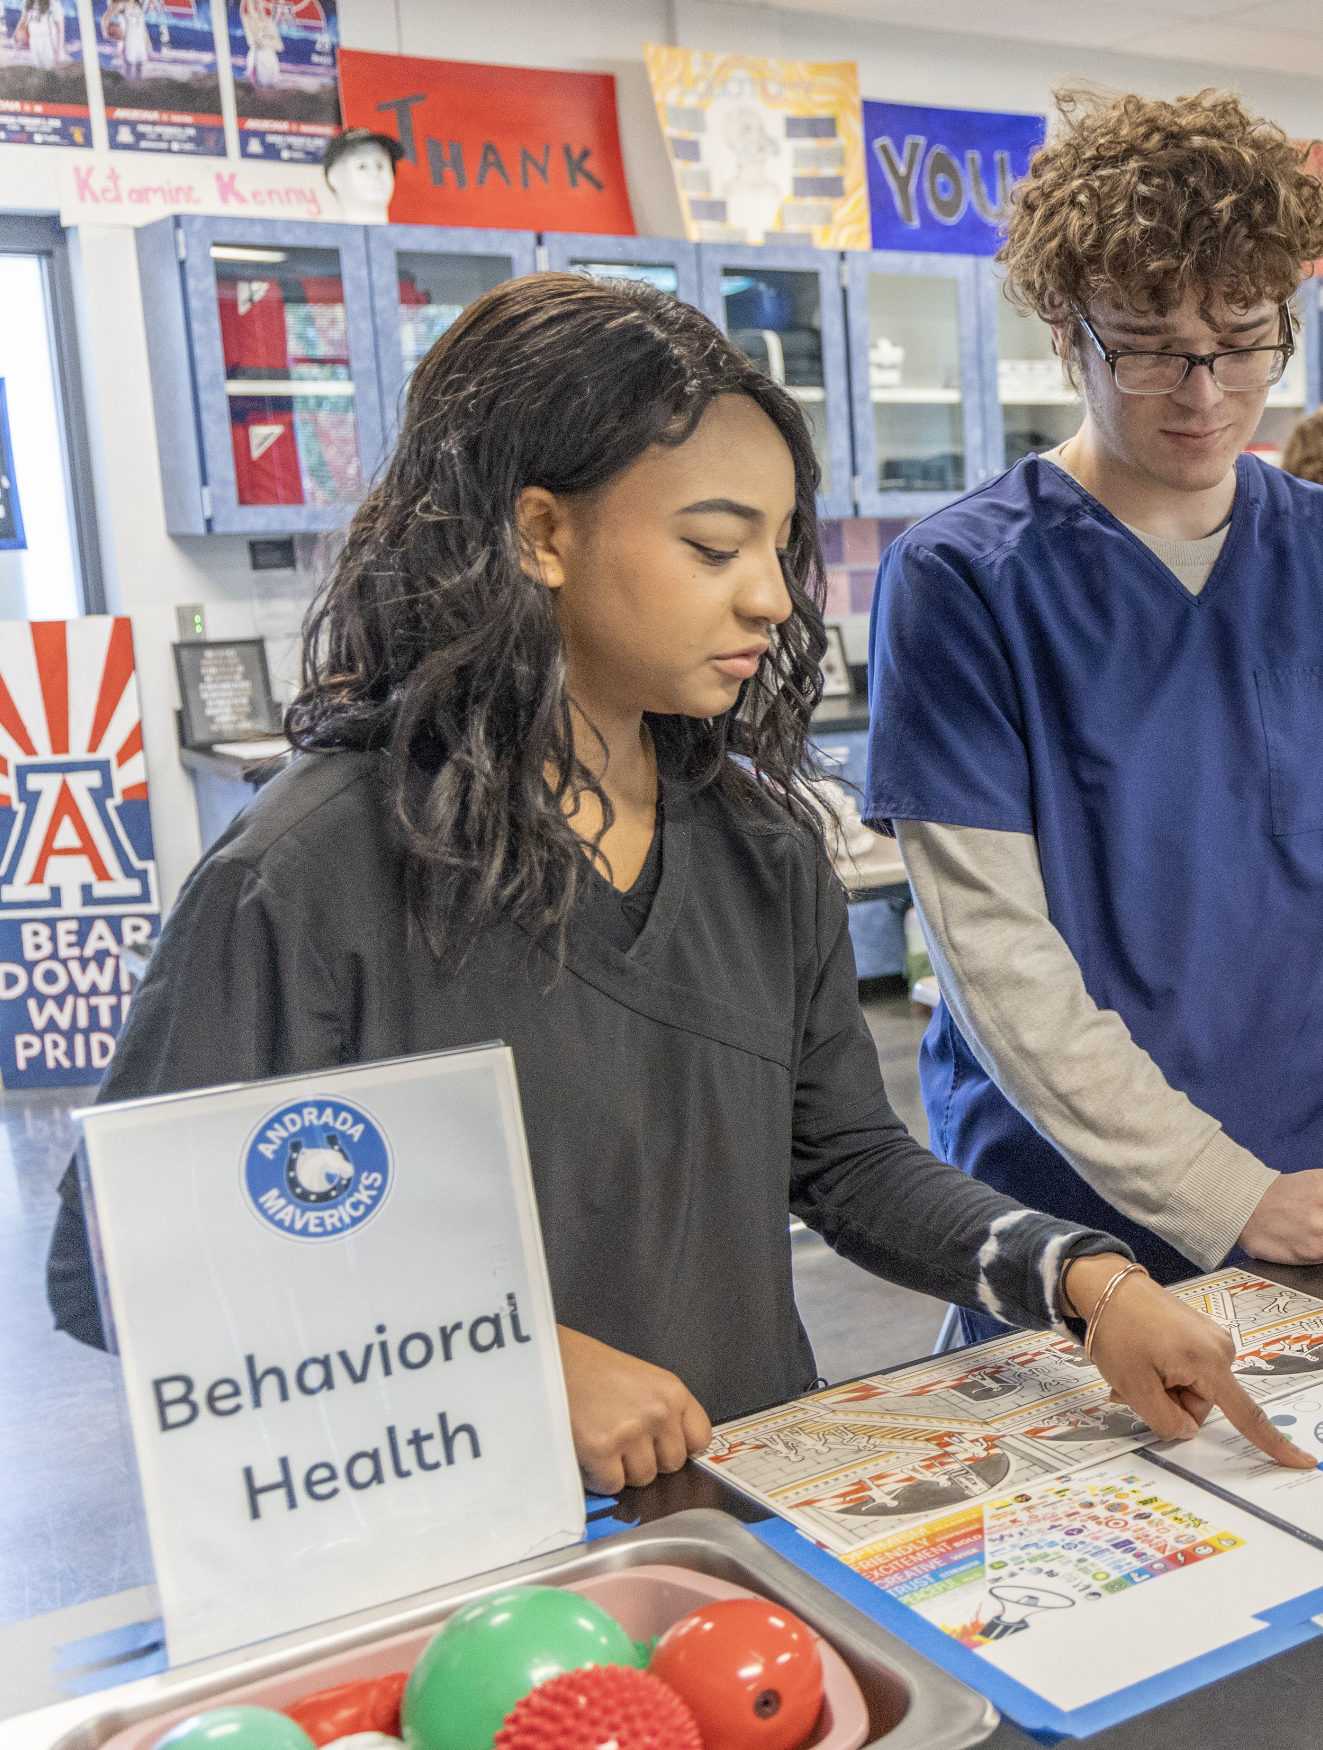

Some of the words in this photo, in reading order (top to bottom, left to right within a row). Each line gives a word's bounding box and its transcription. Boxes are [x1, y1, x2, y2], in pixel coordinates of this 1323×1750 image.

[376, 93, 604, 191] THANK
[214, 171, 322, 217] Kenny
[873, 135, 1012, 229] YOU
[2, 770, 142, 900] A
[21, 916, 151, 961] BEAR
[27, 994, 132, 1031] WIT
[14, 1032, 116, 1070] PRID
[257, 1107, 365, 1160] ANDRADA
[259, 1171, 383, 1233] MAVERICKS
[152, 1292, 531, 1432] Behavioral
[241, 1411, 482, 1521] Health
[841, 1526, 929, 1563] OPTIMISM
[851, 1538, 930, 1572] FRIENDLY
[861, 1542, 952, 1581] EXCITEMENT
[953, 1534, 982, 1548] BOLD
[874, 1557, 948, 1590] CREATIVE
[886, 1573, 936, 1598] TRUST
